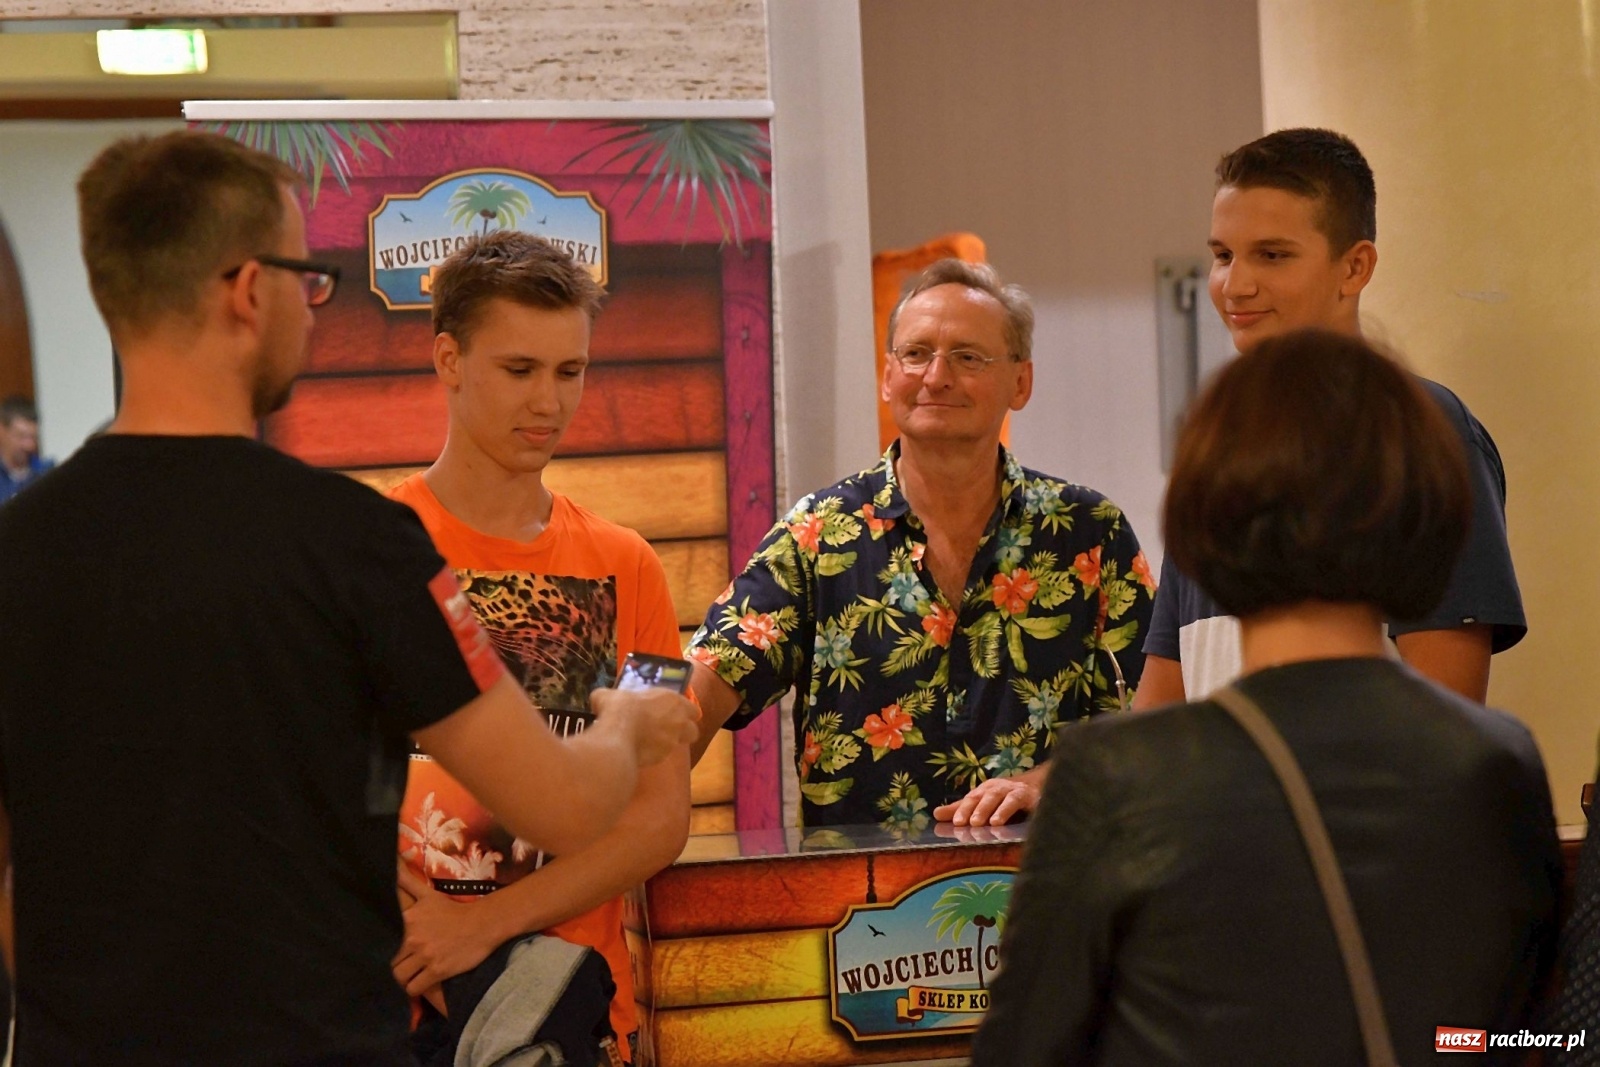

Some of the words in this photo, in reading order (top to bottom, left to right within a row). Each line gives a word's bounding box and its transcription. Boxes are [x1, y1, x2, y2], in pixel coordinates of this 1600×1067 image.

[379, 236, 480, 270] WOJCIEC
[841, 947, 974, 995] WOJCIECH
[918, 990, 965, 1009] SKLEP
[969, 993, 990, 1009] KO
